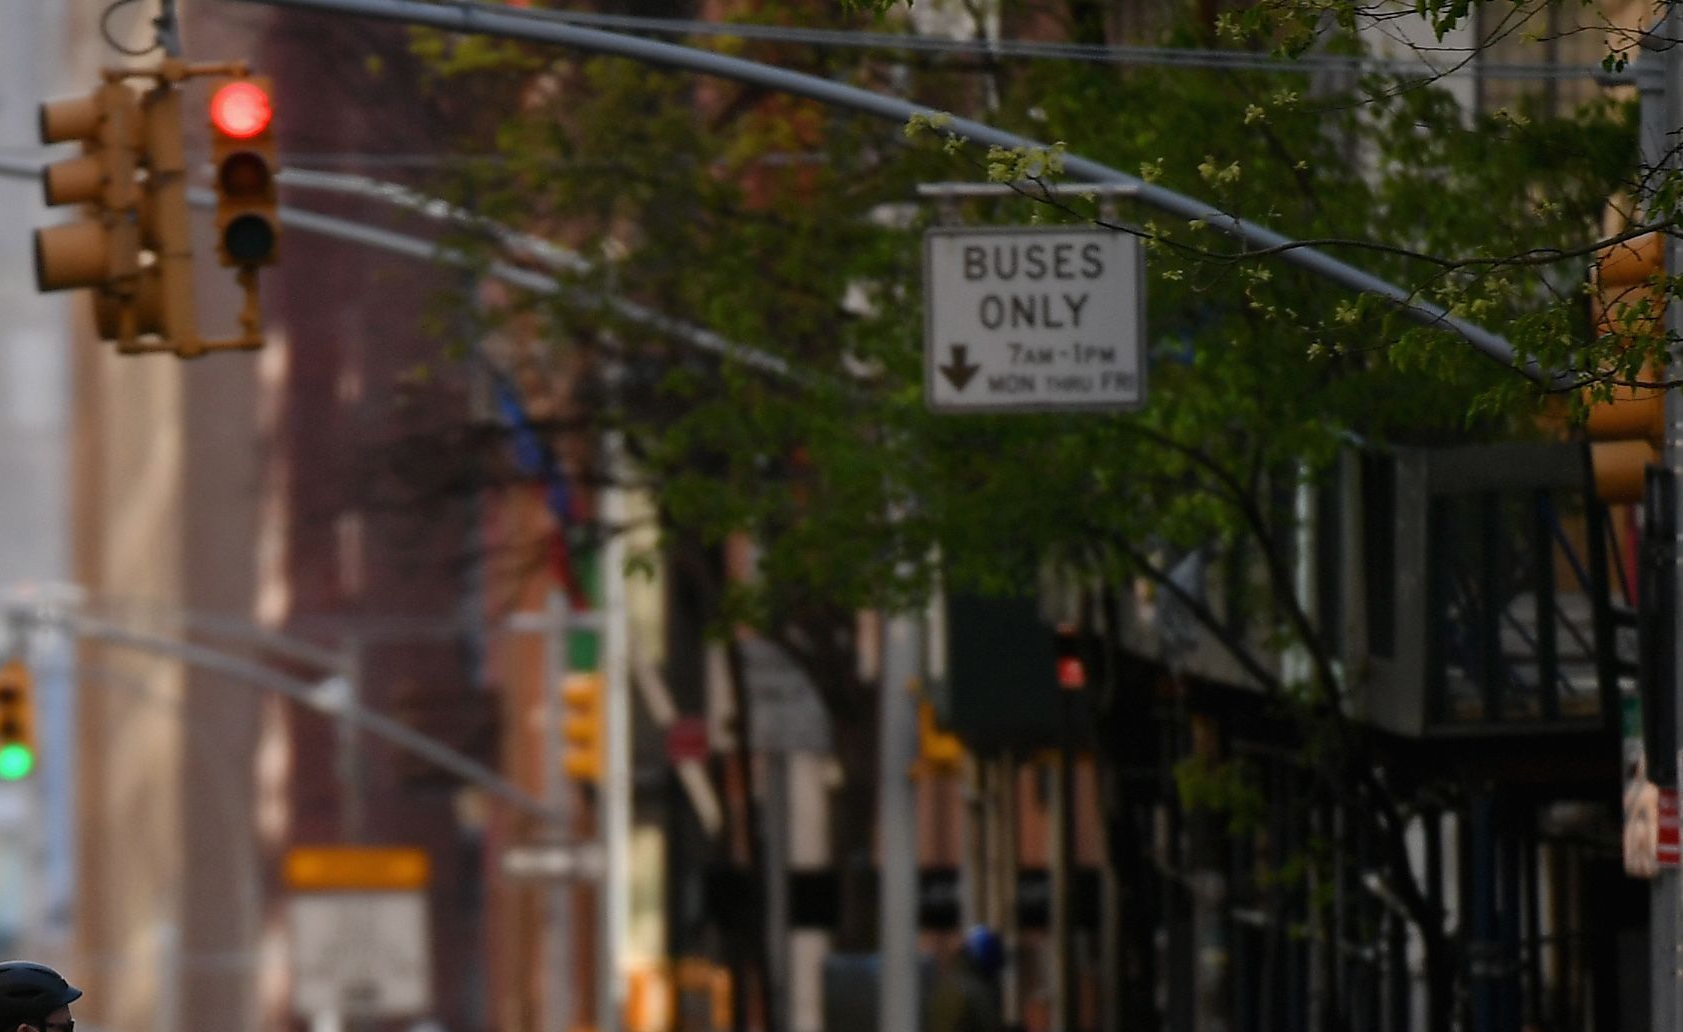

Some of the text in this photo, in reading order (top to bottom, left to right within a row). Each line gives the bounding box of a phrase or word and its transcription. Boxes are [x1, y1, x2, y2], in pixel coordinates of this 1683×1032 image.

[963, 243, 1104, 281] BUSES
[978, 294, 1089, 330] ONLY
[988, 374, 1036, 393] MON
